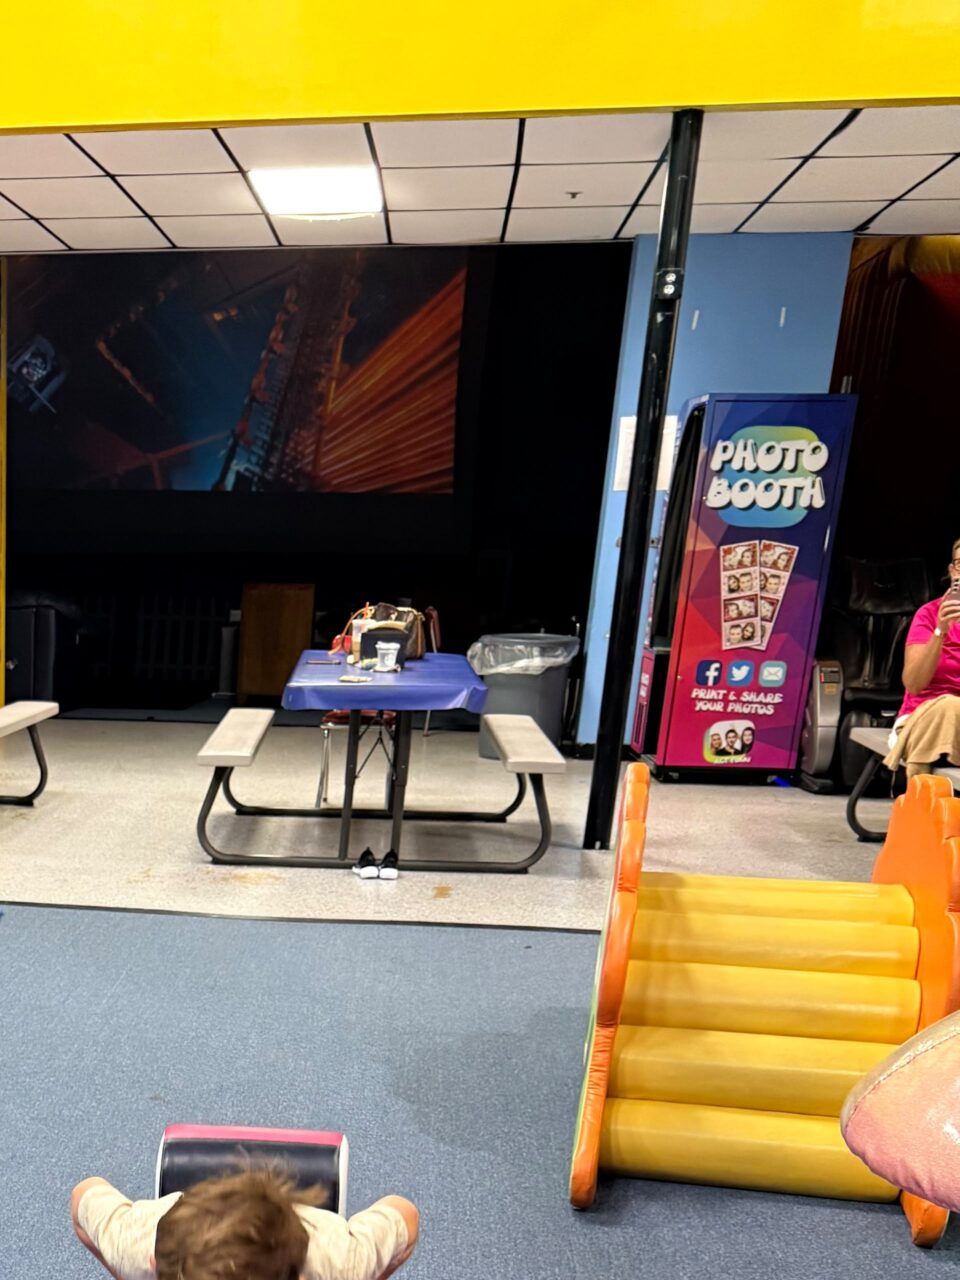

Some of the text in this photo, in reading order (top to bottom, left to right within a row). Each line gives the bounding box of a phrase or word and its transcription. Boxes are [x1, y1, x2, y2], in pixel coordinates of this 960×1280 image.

[710, 439, 829, 472] PHOTO
[705, 476, 826, 509] BOOTH
[691, 688, 727, 700] PRINT
[740, 691, 784, 703] SHARE
[695, 700, 775, 715] YOUR PHOTOS
